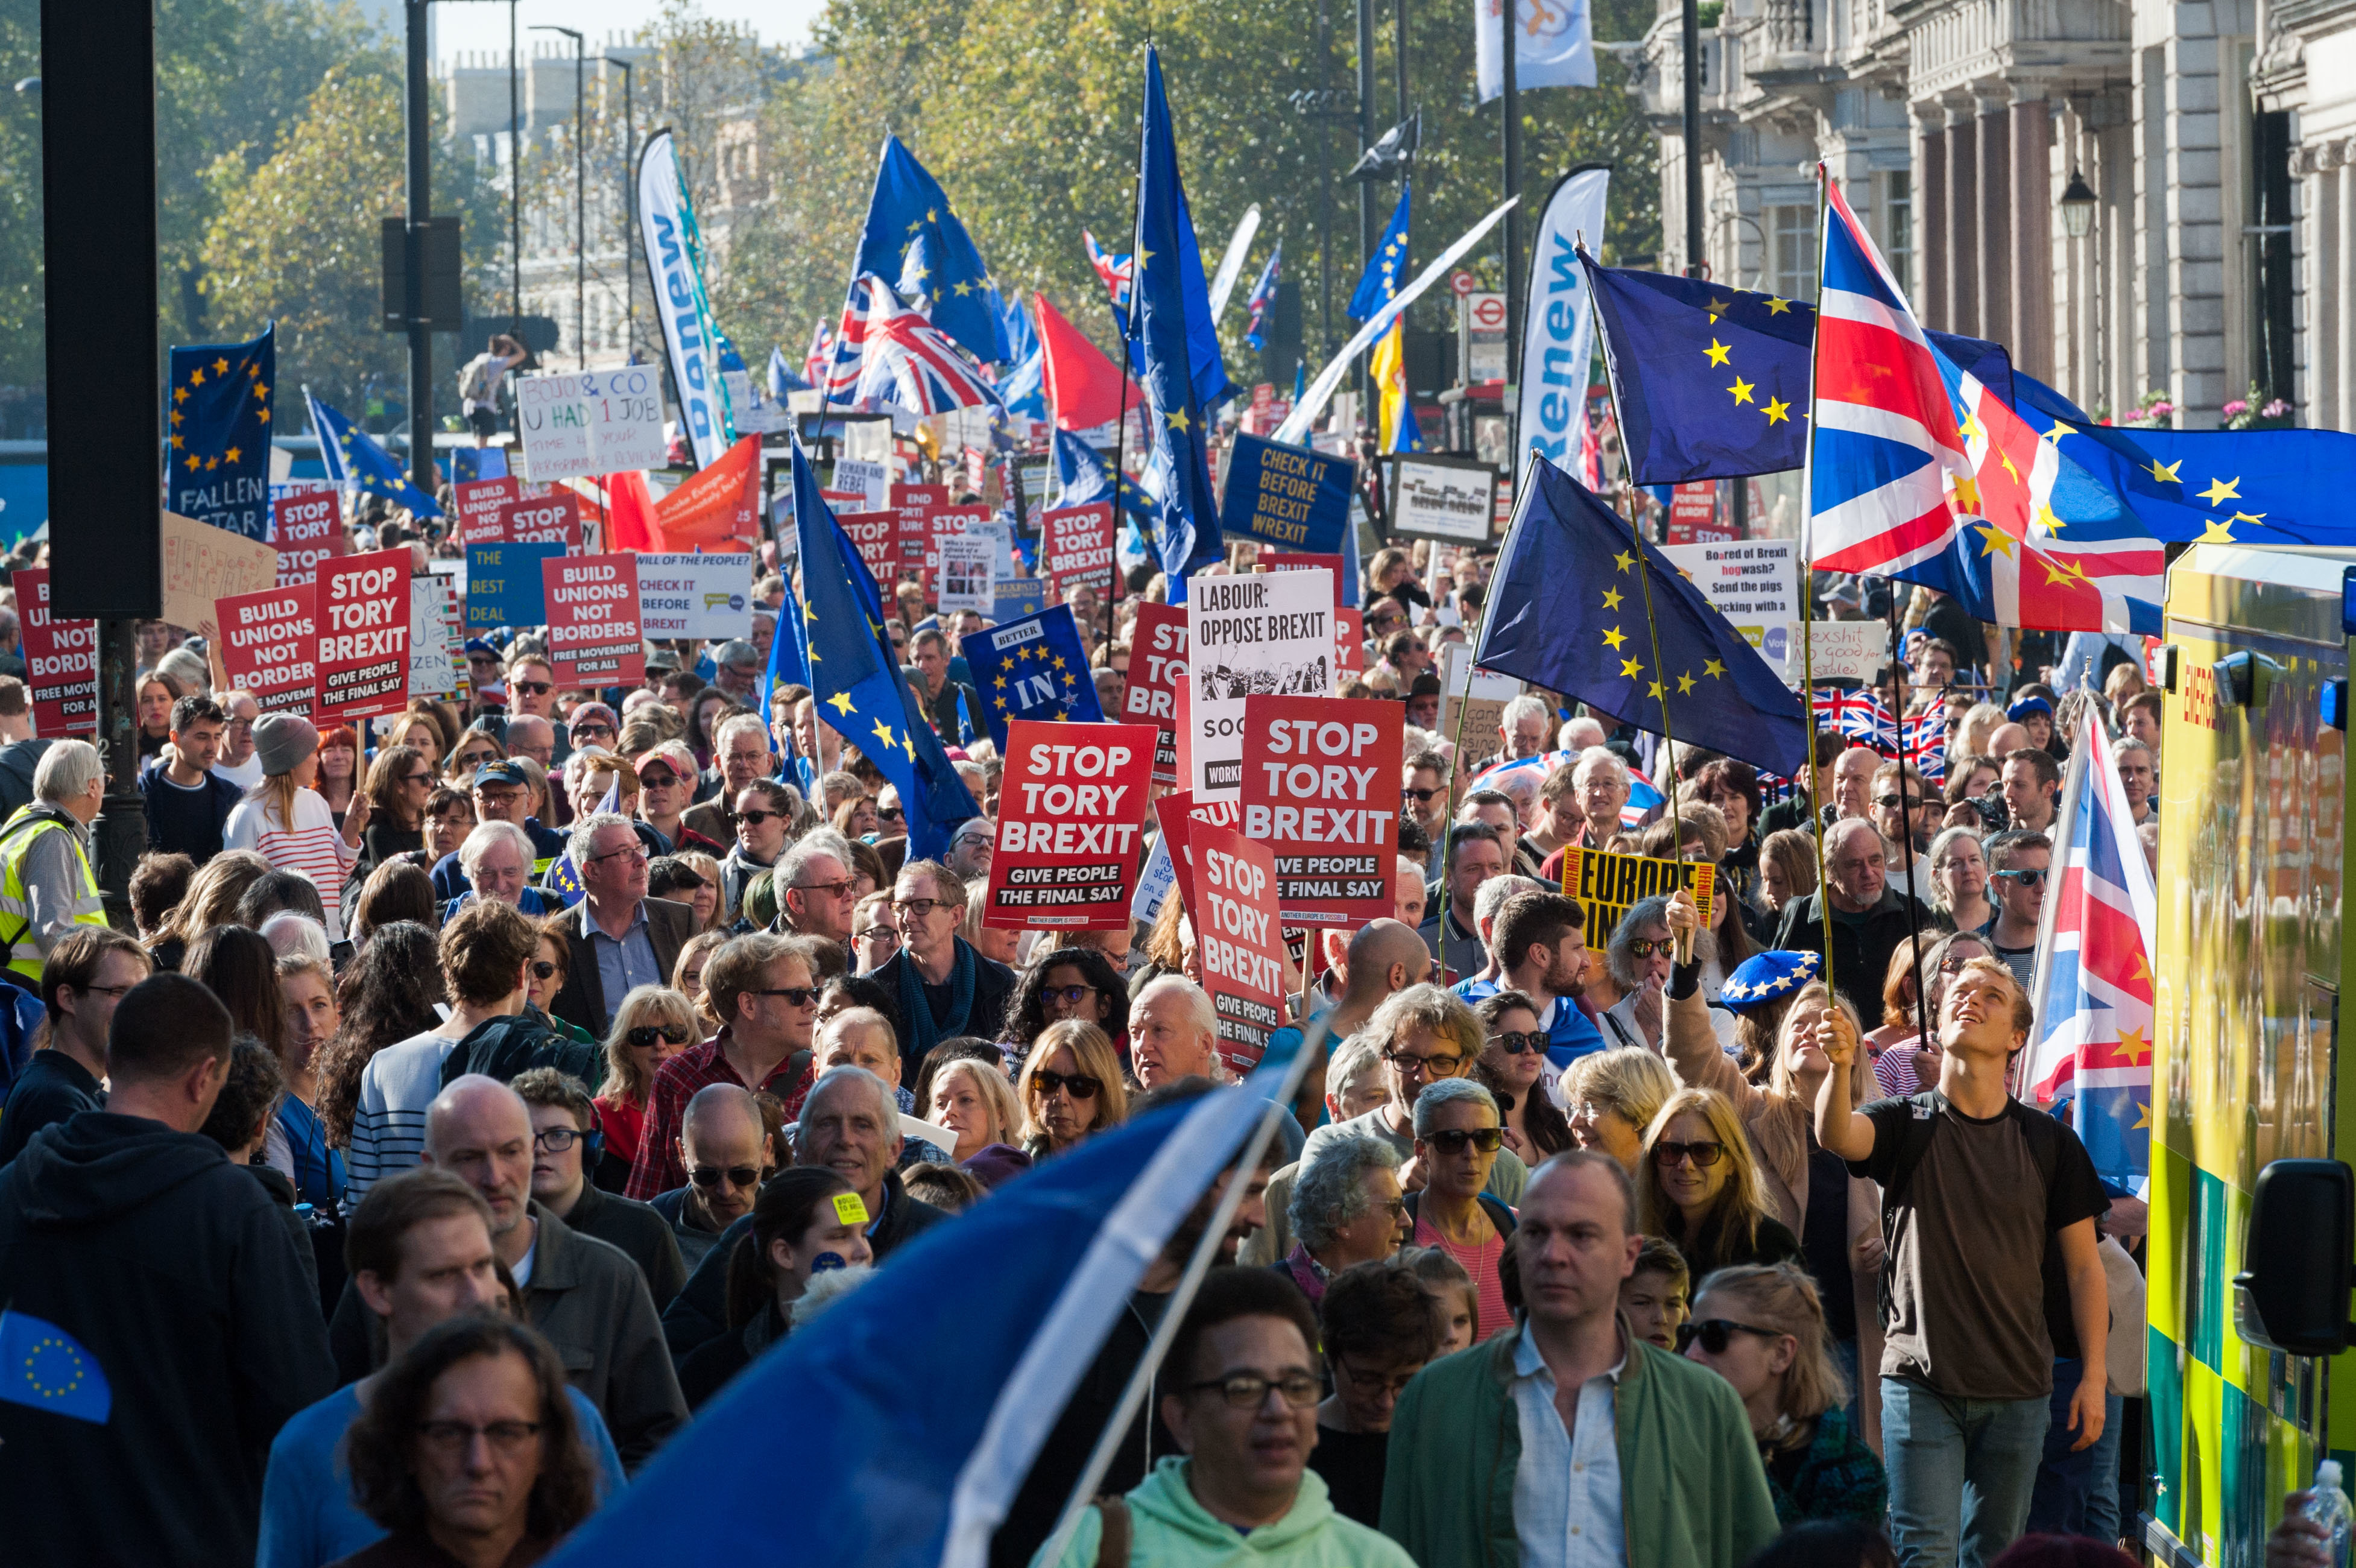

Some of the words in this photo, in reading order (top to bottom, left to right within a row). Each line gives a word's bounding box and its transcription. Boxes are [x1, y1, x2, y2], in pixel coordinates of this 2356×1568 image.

[525, 376, 576, 405] BOJO
[581, 375, 599, 396] &
[610, 372, 647, 394] CO
[525, 408, 542, 431] U
[552, 403, 591, 428] HAD
[601, 398, 611, 422] 1
[619, 397, 658, 422] JOB
[839, 461, 867, 475] REMAIN
[868, 467, 883, 479] AND
[1261, 448, 1309, 477] CHECK
[1312, 462, 1328, 481] IT
[180, 477, 263, 513] FALLEN
[469, 485, 505, 501] BUILD
[1259, 470, 1318, 502] BEFORE
[906, 493, 932, 504] END
[1257, 493, 1311, 522] BREXIT
[1673, 494, 1714, 504] FORTRESS
[285, 501, 330, 523] STOP
[513, 506, 566, 530] STOP
[1676, 507, 1710, 517] EUROPE
[285, 519, 330, 541] TORY
[1053, 513, 1101, 535] STOP
[1252, 513, 1309, 544] WREXIT
[1054, 531, 1104, 552] TORY
[1696, 530, 1732, 542] STOP
[475, 551, 502, 565] THE
[664, 555, 678, 565] OF
[681, 555, 700, 564] THE
[703, 555, 749, 566] PEOPLE?
[1052, 548, 1113, 572] BREXIT
[1706, 548, 1742, 561] Boared
[1744, 548, 1754, 559] of
[1757, 548, 1787, 558] Brexit
[563, 566, 616, 583] BUILD
[1722, 563, 1775, 576] hogwash?
[331, 566, 397, 599] STOP
[472, 580, 505, 593] BEST
[554, 583, 628, 602] UNIONS
[639, 580, 678, 591] CHECK
[684, 580, 695, 591] IT
[1712, 582, 1739, 593] Send
[1741, 581, 1757, 592] the
[1760, 581, 1782, 593] pigs
[642, 599, 690, 610] BEFORE
[1200, 583, 1269, 612] LABOUR:
[1755, 601, 1778, 612] with
[1780, 602, 1786, 611] a
[239, 599, 298, 624] BUILD
[329, 597, 398, 631] TORY
[470, 607, 505, 621] DEAL
[573, 604, 613, 621] NOT
[230, 618, 315, 647] UNIONS
[552, 622, 637, 642] BORDERS
[643, 619, 687, 630] BREXIT
[998, 625, 1038, 646] BETTER
[1201, 616, 1263, 646] OPPOSE
[1268, 612, 1325, 641] BREXIT
[1795, 626, 1863, 645] Bexshit
[52, 627, 95, 650] NOT
[319, 626, 407, 663] BREXIT
[254, 642, 298, 665] NOT
[554, 650, 578, 661] FREE
[580, 643, 639, 659] MOVEMENT
[1863, 648, 1881, 662] for
[329, 671, 356, 687] GIVE
[359, 661, 398, 680] PEOPLE
[577, 662, 598, 672] FOR
[600, 659, 618, 669] ALL
[35, 688, 62, 701] FREE
[323, 689, 345, 706] THE
[348, 683, 379, 700] FINAL
[381, 677, 402, 692] SAY
[1014, 671, 1057, 710] IN
[63, 701, 86, 715] FOR
[99, 738, 110, 758] 2
[1267, 719, 1379, 757] STOP
[1027, 744, 1131, 777] STOP
[1263, 762, 1379, 800] TORY
[1022, 783, 1129, 815] TORY
[1245, 805, 1393, 844] BREXIT
[1000, 821, 1139, 854] BREXIT
[1011, 868, 1052, 883] GIVE
[1056, 866, 1119, 882] PEOPLE
[1207, 848, 1265, 901] STOP
[1307, 858, 1375, 873] PEOPLE
[1565, 848, 1581, 897] MOVEMENT
[1144, 884, 1154, 893] on
[1154, 869, 1173, 887] stop
[1288, 882, 1342, 897] FINAL
[1346, 881, 1383, 897] SAY
[1698, 865, 1713, 896] DEFEND
[1000, 890, 1033, 903] THE
[1037, 888, 1085, 903] FINAL
[1090, 886, 1123, 900] SAY
[1207, 891, 1270, 947] TORY
[1204, 934, 1281, 997] BREXIT
[1216, 994, 1241, 1016] GIVE
[1243, 1001, 1277, 1026] PEOPLE
[1235, 1023, 1262, 1046] FINAL
